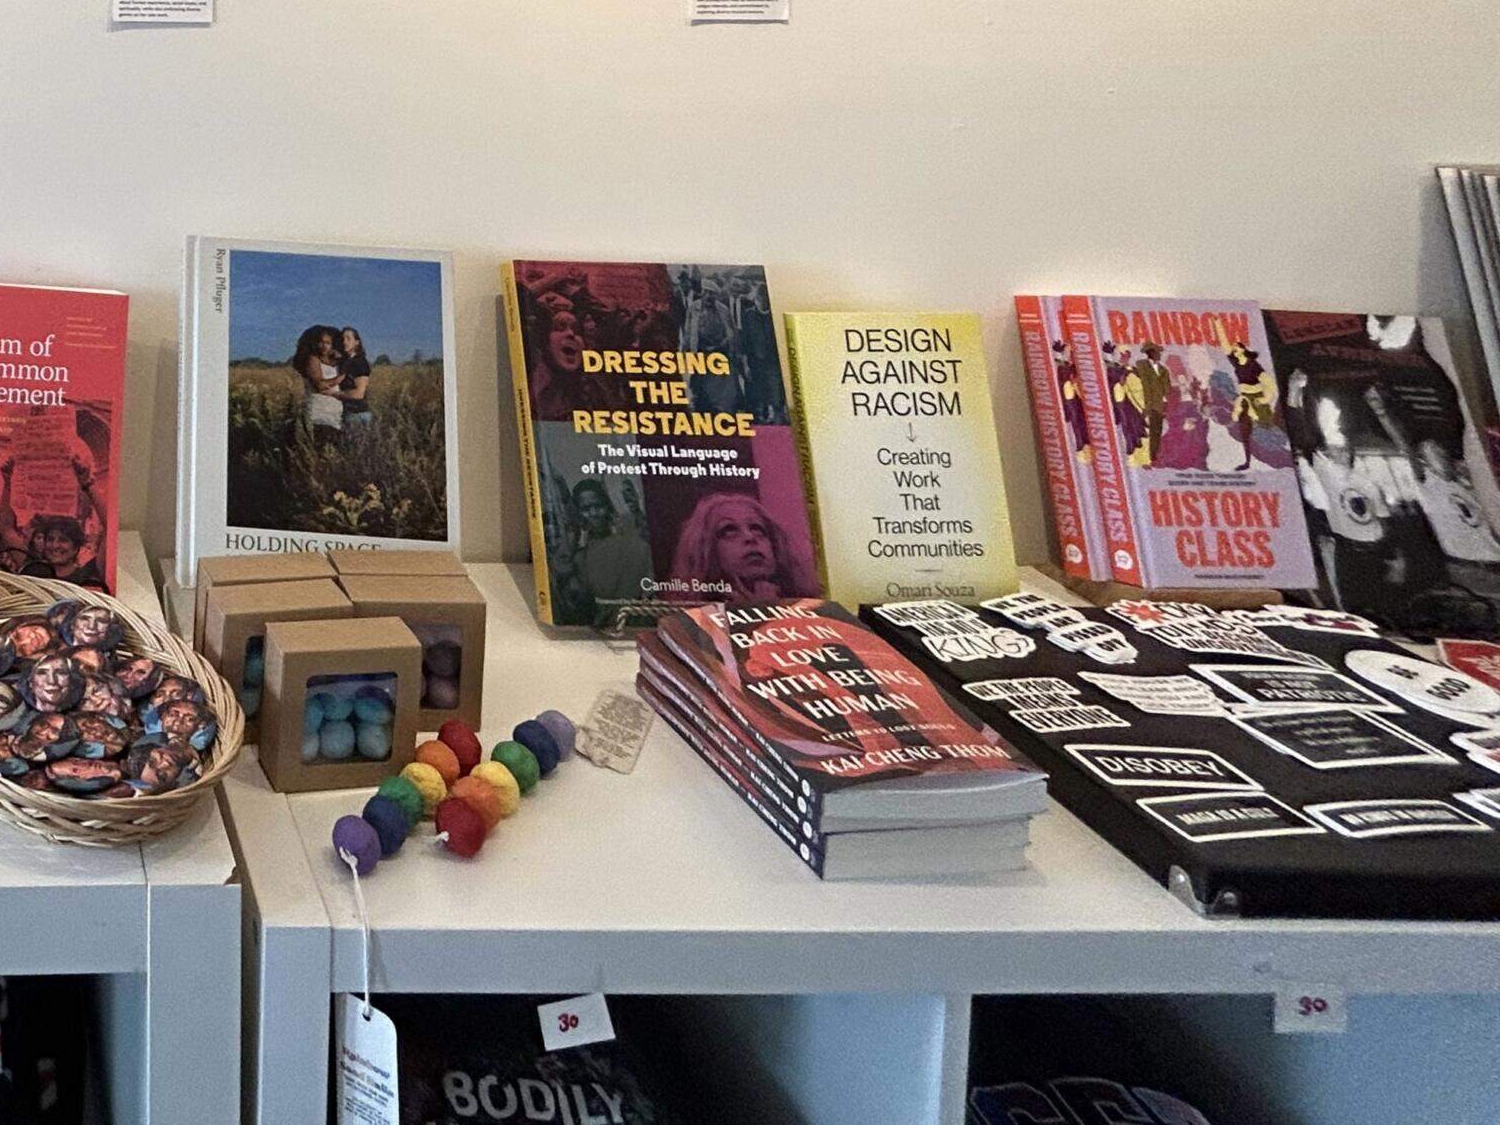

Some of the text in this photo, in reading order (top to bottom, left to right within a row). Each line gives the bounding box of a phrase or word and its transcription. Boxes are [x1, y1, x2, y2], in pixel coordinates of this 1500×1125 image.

[212, 248, 226, 313] Ryan Pfluger
[845, 328, 951, 352] DESIGN
[1108, 311, 1250, 347] RAINBOW
[29, 334, 55, 357] of
[582, 350, 730, 375] DRESSING
[841, 360, 962, 384] AGAINST
[630, 381, 690, 405] THE
[852, 392, 961, 416] RACISM
[573, 410, 756, 437] RESISTANCE
[598, 444, 738, 461] The Visual Language
[877, 448, 951, 468] Creating
[581, 462, 760, 479] of Protest Through History
[893, 471, 941, 488] Work
[900, 493, 940, 511] That
[1148, 491, 1280, 527] HISTORY
[872, 517, 973, 534] Transforms
[225, 533, 319, 553] HOLDING
[868, 540, 984, 558] Communities
[1175, 530, 1274, 568] CLASS
[640, 578, 733, 593] Camille Benda
[886, 582, 975, 599] Omari Souza
[710, 603, 819, 628] FALLING
[731, 624, 842, 649] BACK IN
[771, 645, 851, 669] LOVE
[746, 667, 922, 700] WITH BEING
[802, 693, 921, 721] HUMAN
[820, 741, 1009, 775] KAI CHENG THOM
[1094, 755, 1226, 777] DISOBEY
[1299, 995, 1328, 1016] 30
[557, 1012, 580, 1033] 30
[443, 1069, 626, 1125] BODILY
